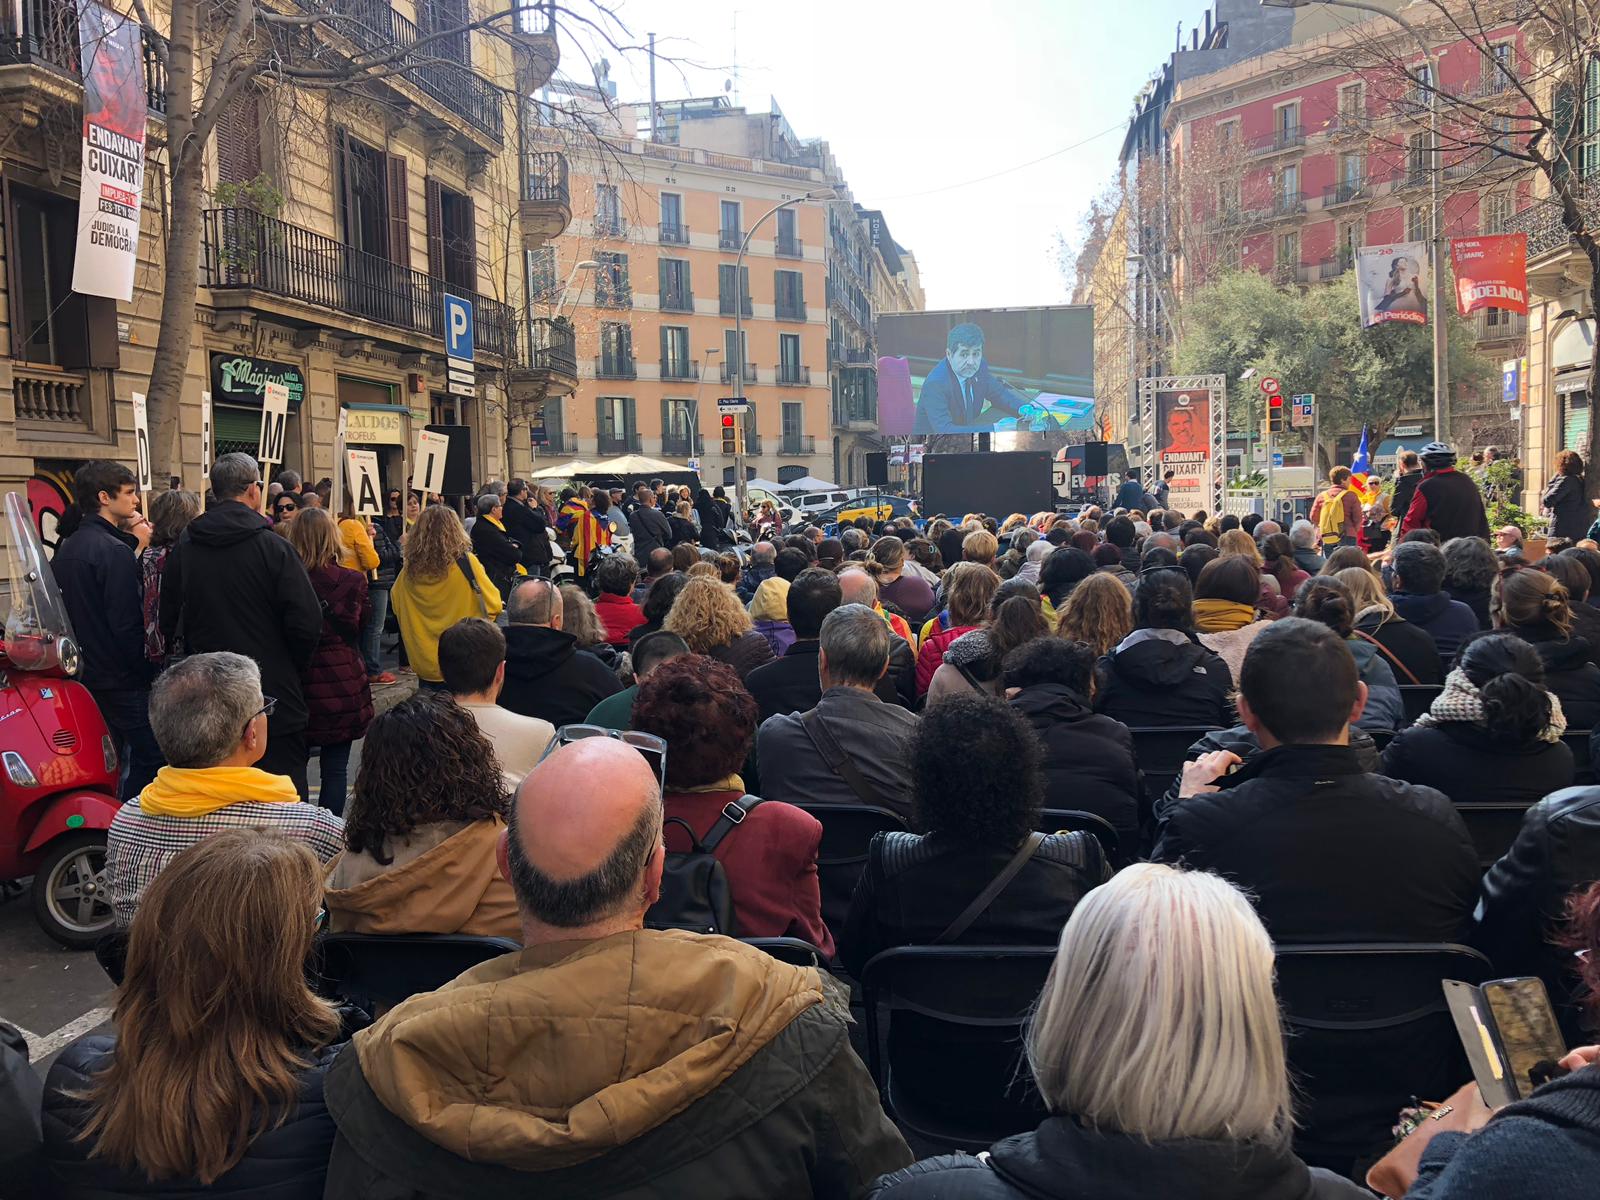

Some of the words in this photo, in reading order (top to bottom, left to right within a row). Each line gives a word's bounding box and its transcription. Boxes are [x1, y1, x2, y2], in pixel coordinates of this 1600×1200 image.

[92, 220, 115, 234] JUDICI
[117, 226, 121, 235] A
[122, 228, 128, 237] LA
[450, 303, 467, 349] P
[137, 428, 149, 486] D
[261, 411, 284, 460] M
[358, 465, 380, 512] À
